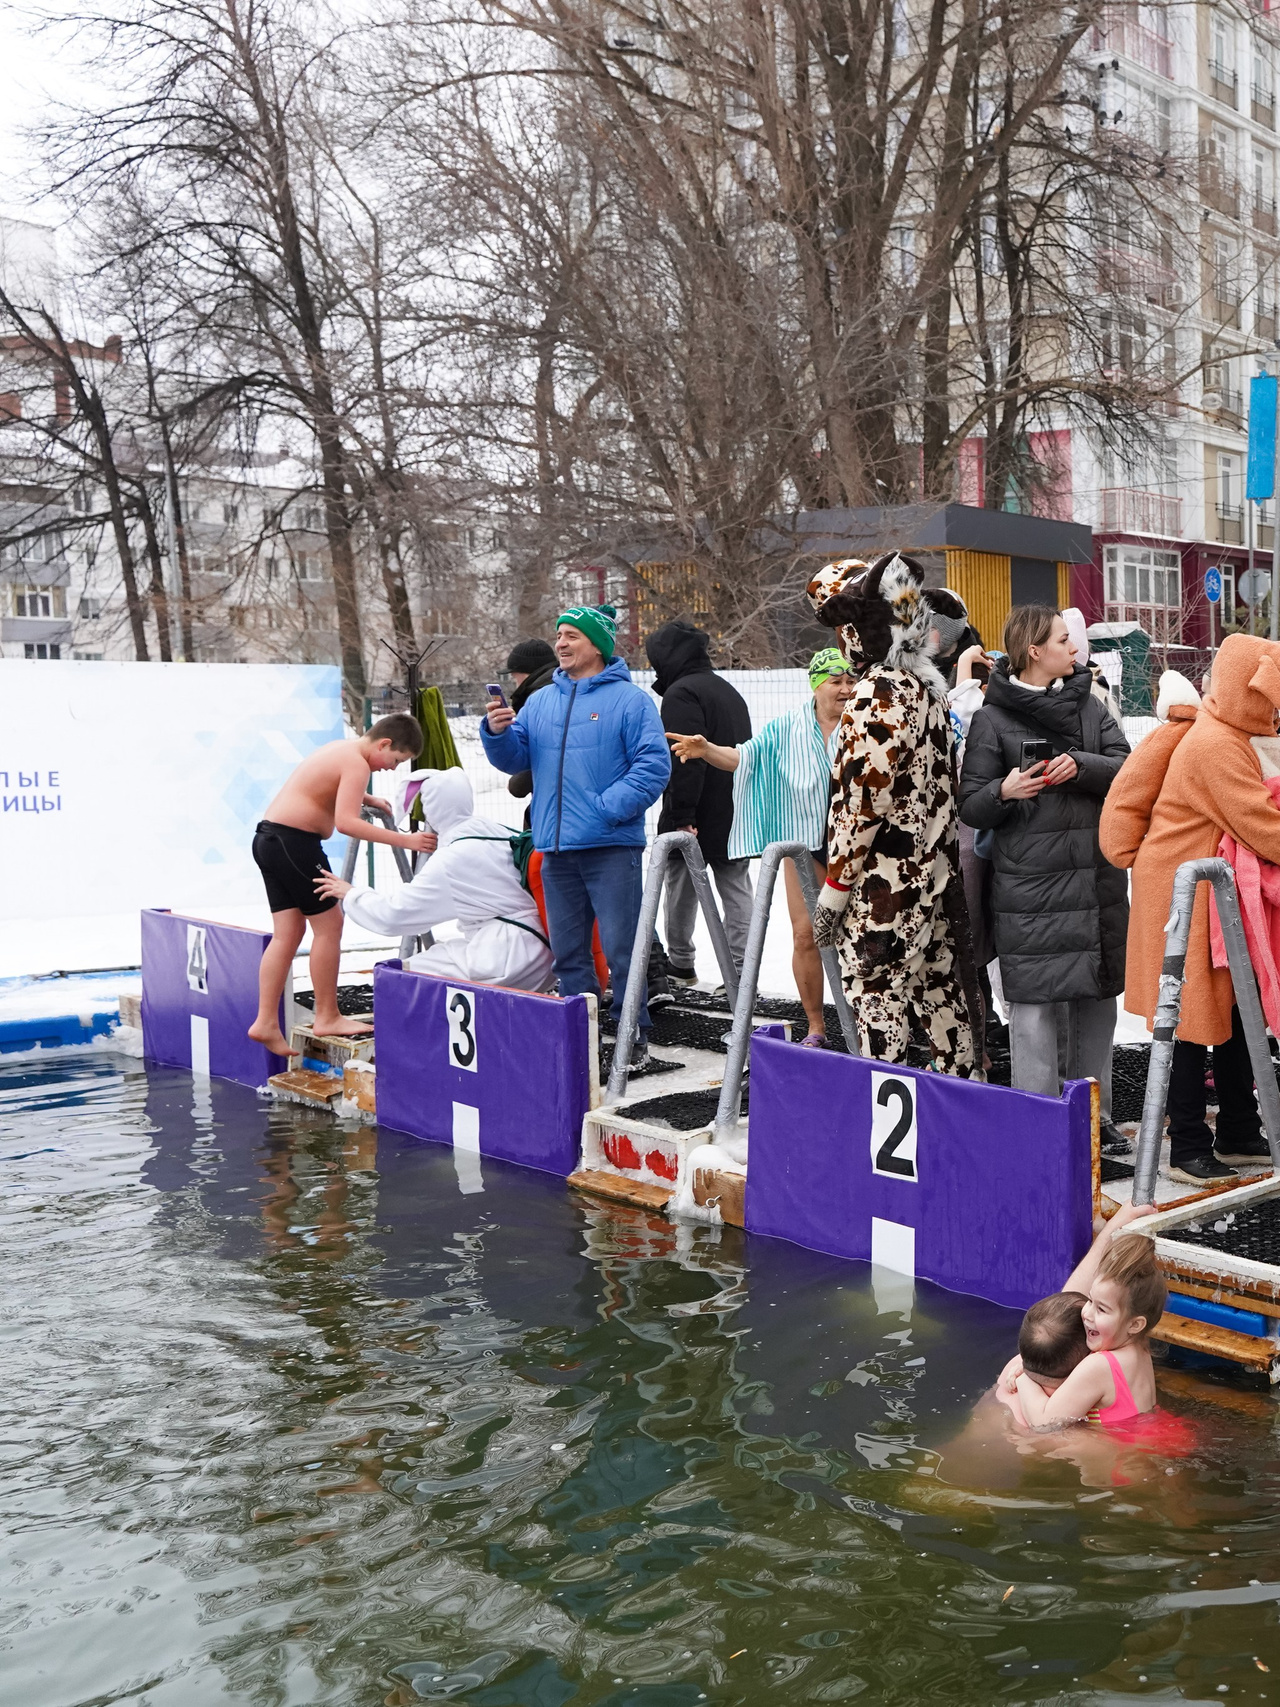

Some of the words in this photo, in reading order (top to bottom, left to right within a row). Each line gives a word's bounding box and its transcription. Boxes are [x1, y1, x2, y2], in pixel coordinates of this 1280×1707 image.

[3, 795, 61, 814] ИЦЫ
[189, 930, 205, 990] 4
[449, 993, 475, 1067] 3
[876, 1078, 915, 1177] 2
